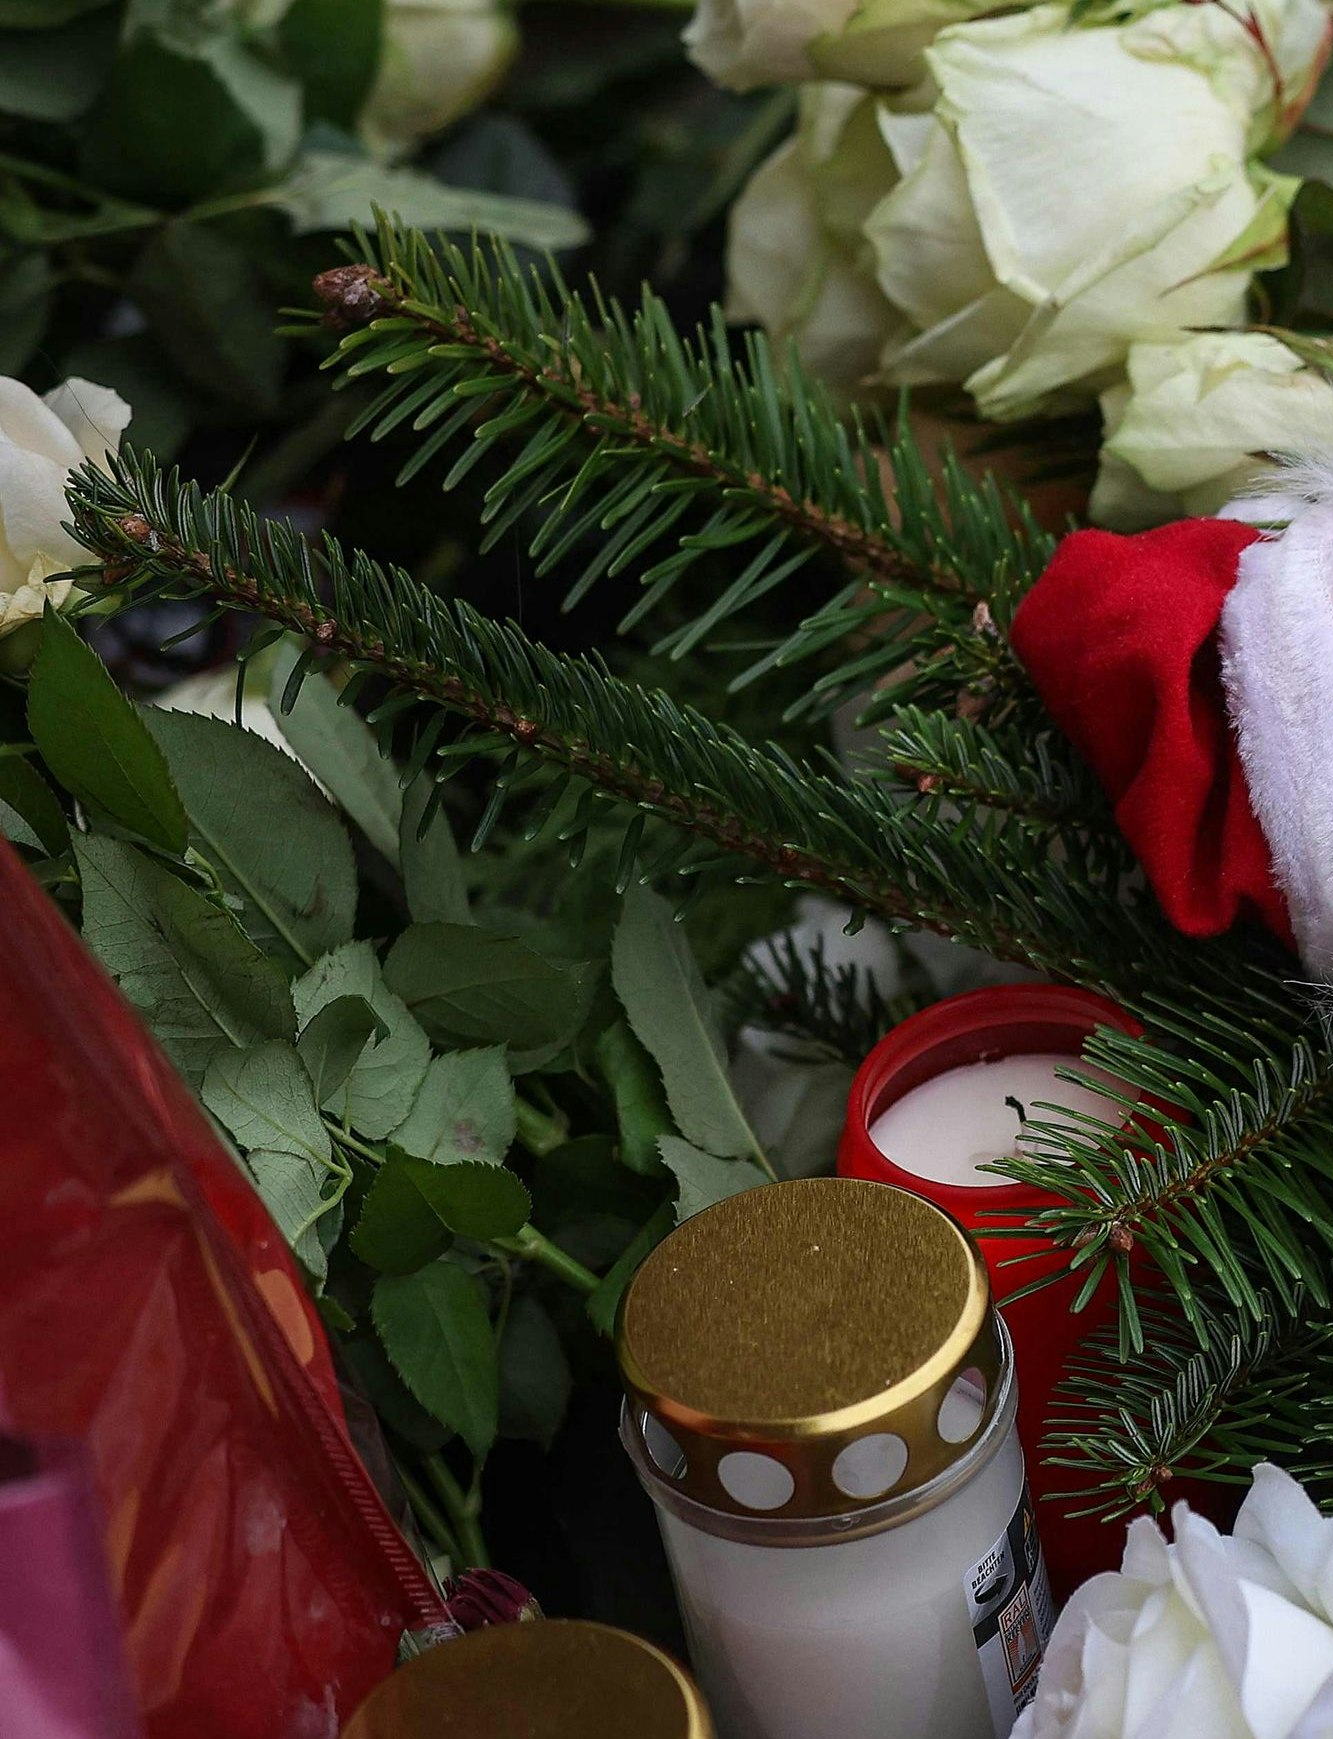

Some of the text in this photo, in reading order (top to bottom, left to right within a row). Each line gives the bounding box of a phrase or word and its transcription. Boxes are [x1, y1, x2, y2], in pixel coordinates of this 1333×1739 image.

[971, 1551, 1005, 1590] BEACHTEN
[977, 1551, 996, 1574] BITTE
[1003, 1596, 1027, 1629] RAL
